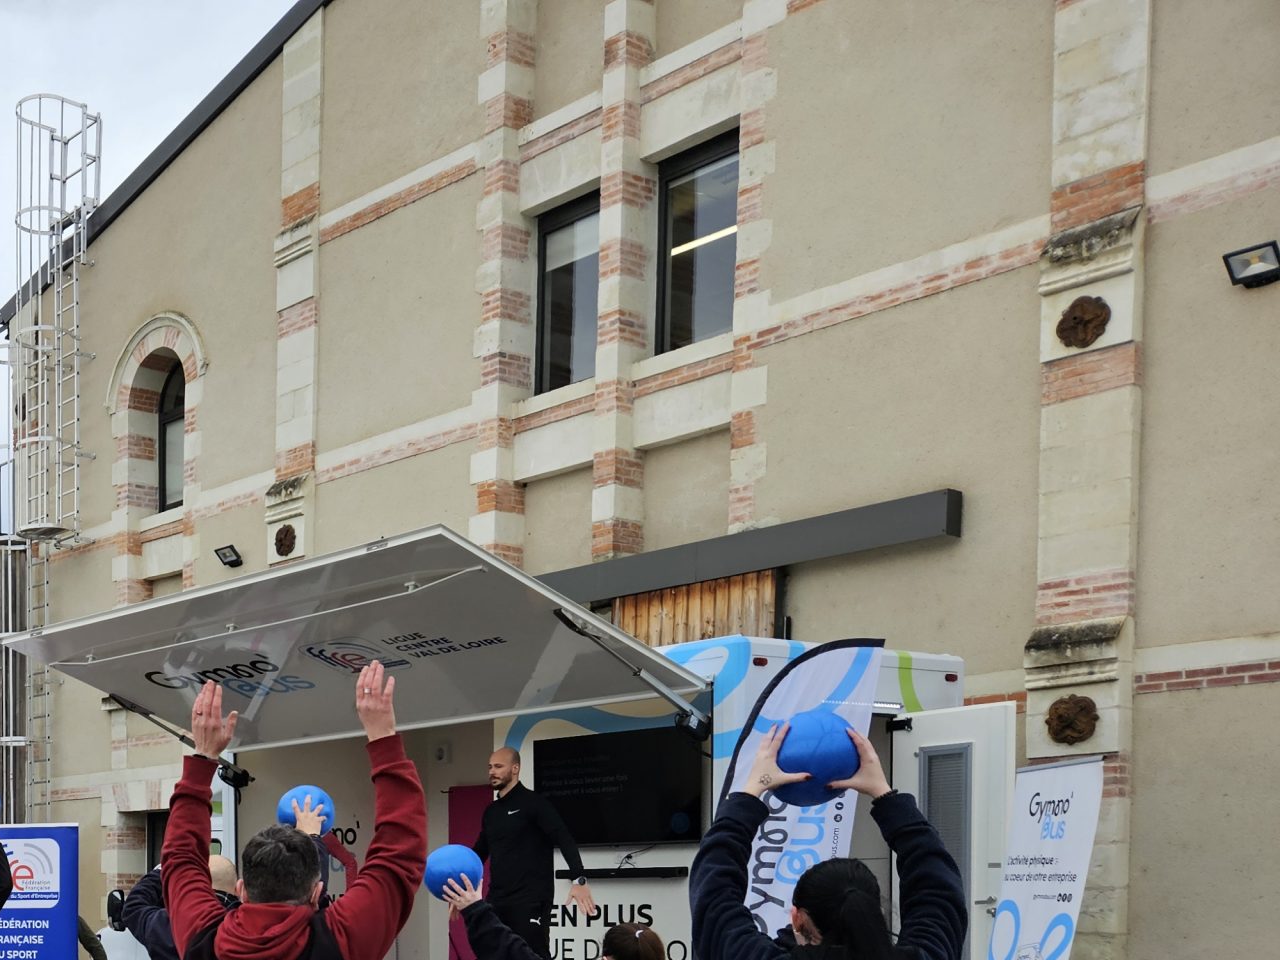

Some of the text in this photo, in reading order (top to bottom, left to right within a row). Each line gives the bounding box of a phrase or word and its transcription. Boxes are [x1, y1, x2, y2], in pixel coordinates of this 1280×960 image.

[382, 632, 426, 645] LIGUE
[396, 637, 453, 652] CENTRE
[408, 636, 507, 658] VAL DE LOIRE
[586, 903, 654, 928] PLUS
[7, 950, 38, 959] SPORT
